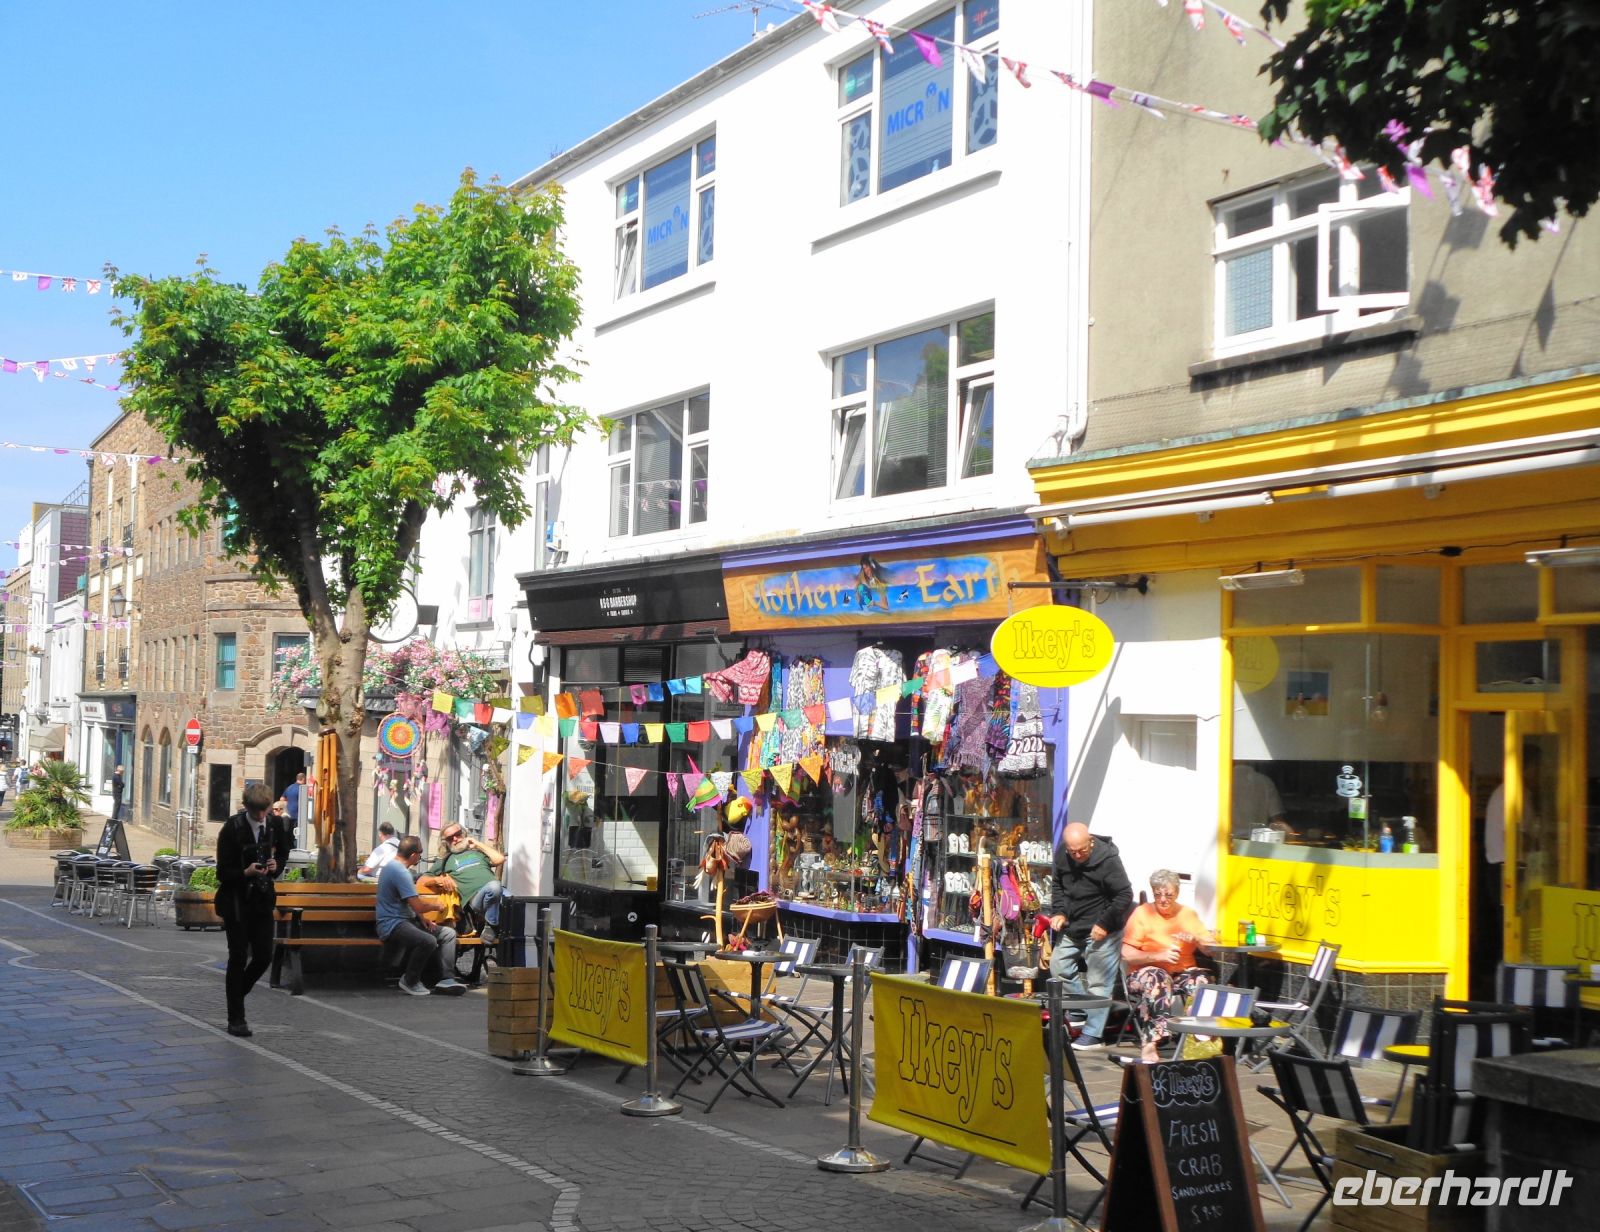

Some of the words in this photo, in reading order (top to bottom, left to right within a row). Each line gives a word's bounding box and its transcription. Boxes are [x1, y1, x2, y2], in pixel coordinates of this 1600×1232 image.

[887, 82, 950, 136] MICRN
[647, 206, 688, 245] MICRN
[742, 571, 840, 612] Mother
[915, 553, 1021, 603] Earth
[1012, 620, 1095, 669] Ikey's
[1247, 868, 1341, 936] Ikey's
[568, 944, 631, 1036] Ikey's
[898, 996, 1014, 1124] Ikey's
[1168, 1067, 1214, 1099] Ikey's
[1168, 1119, 1220, 1147] FRESH
[1178, 1153, 1223, 1176] CRAB
